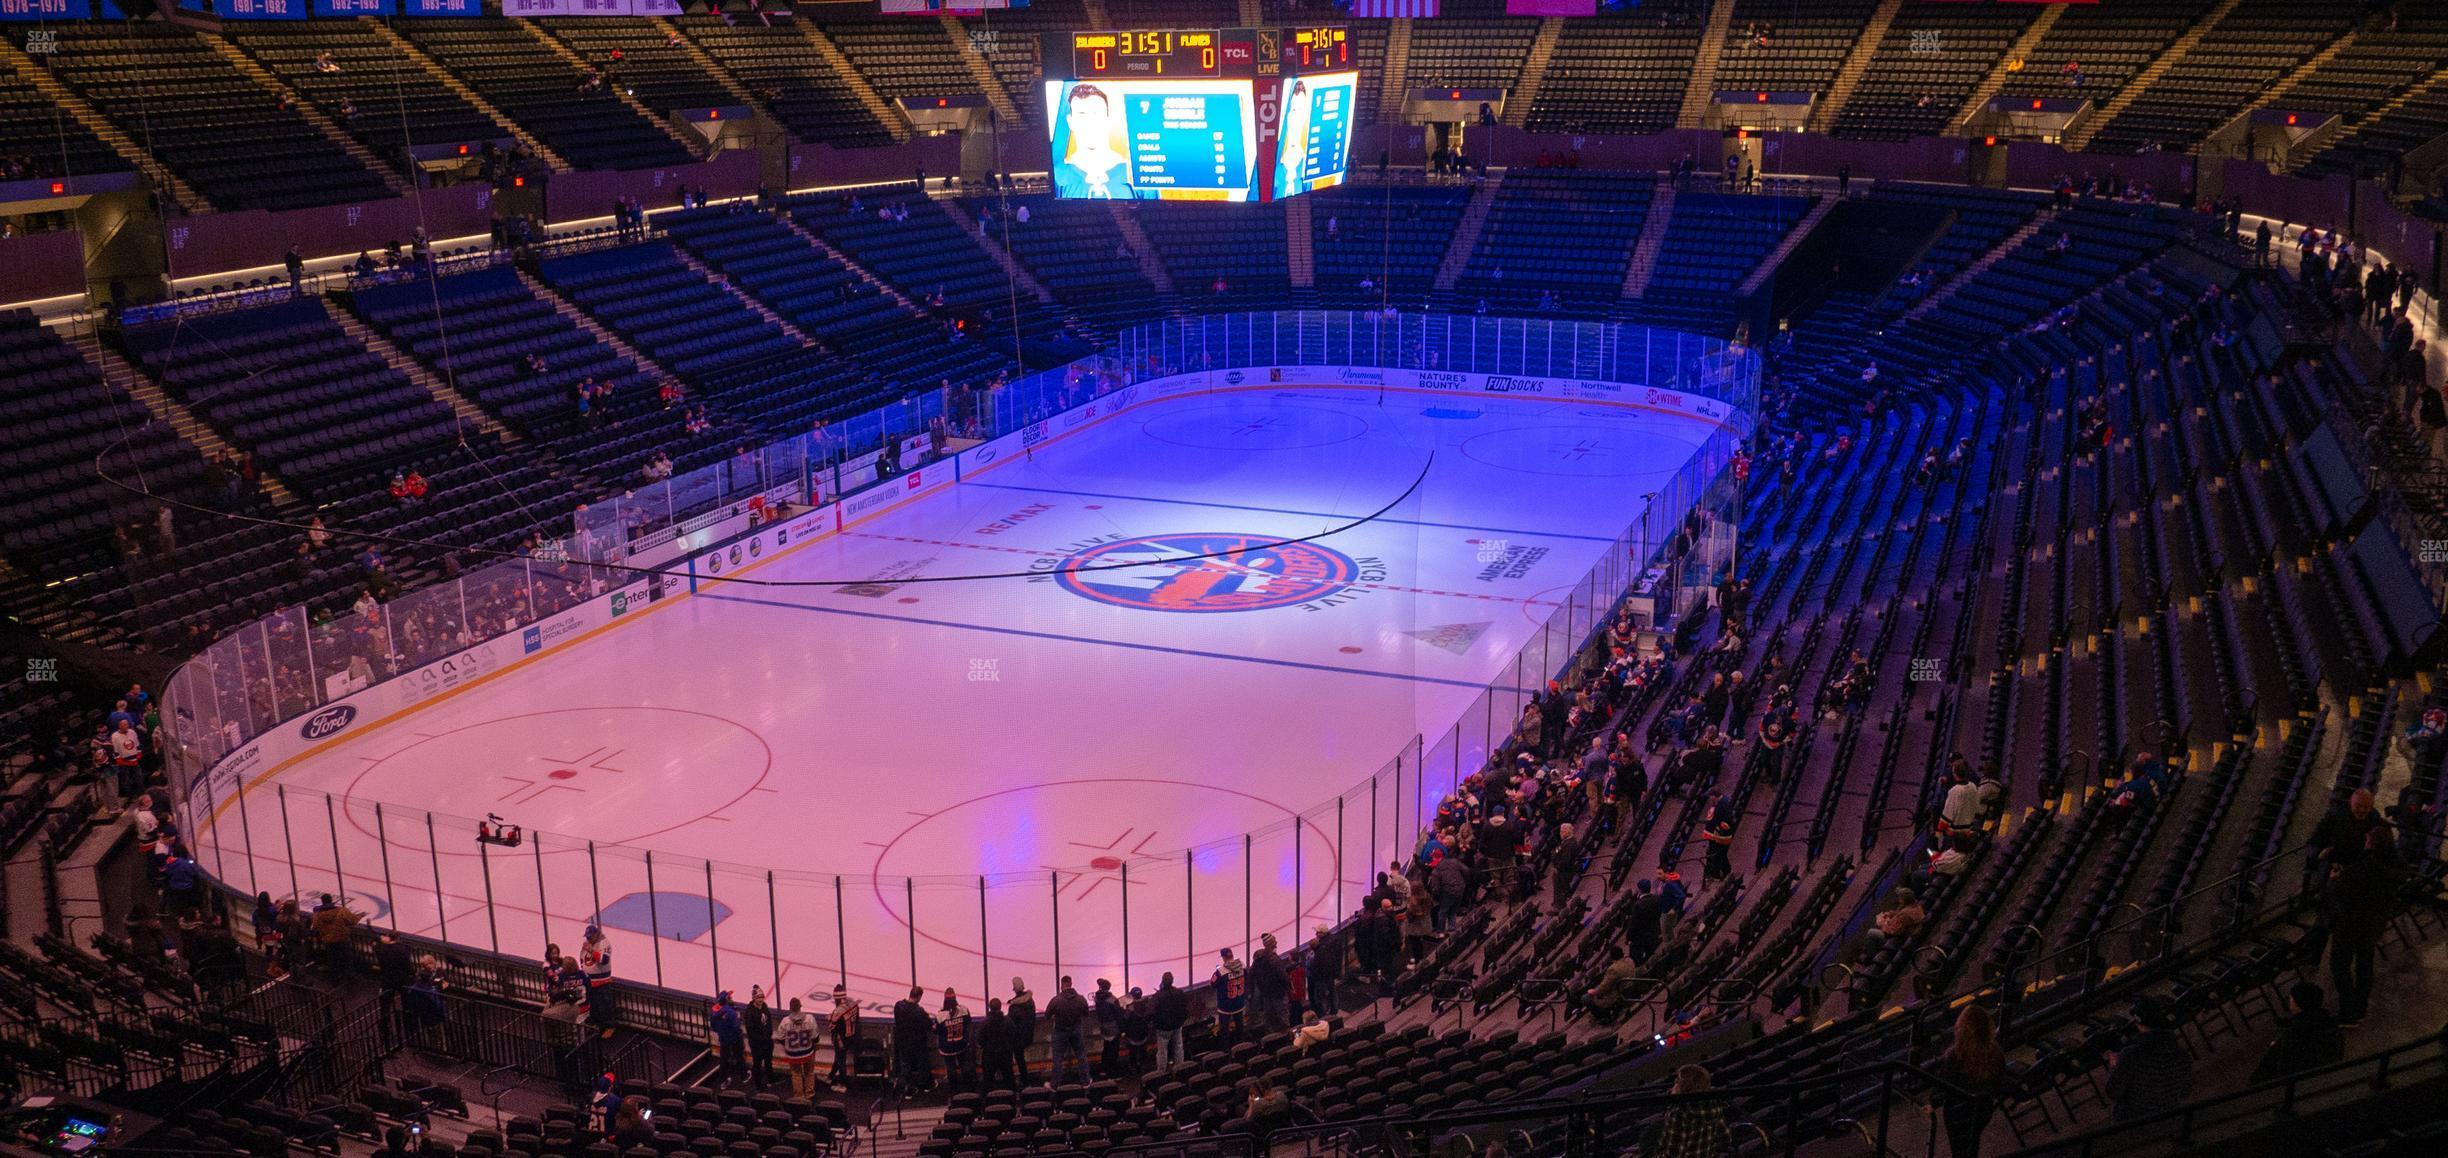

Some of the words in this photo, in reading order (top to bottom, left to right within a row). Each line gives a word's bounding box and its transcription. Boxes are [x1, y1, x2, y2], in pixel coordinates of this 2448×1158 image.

[1121, 32, 1172, 54] 31:51
[1095, 49, 1106, 70] 0
[1202, 48, 1214, 69] 0
[1224, 48, 1249, 59] TCL
[1127, 62, 1149, 71] PERIOD
[1257, 64, 1279, 74] LIVE
[1259, 84, 1277, 143] TCL
[1419, 371, 1467, 383] NATURE'S
[1419, 380, 1460, 390] BOUNTY
[1487, 377, 1511, 391] FUN
[1510, 380, 1544, 392] SOCKS
[1580, 381, 1621, 393] Northwell
[975, 503, 1057, 535] RE/MAX
[1354, 556, 1388, 583] NYCB
[1503, 547, 1551, 580] EXPRESS
[1296, 587, 1372, 613] LIVE
[310, 708, 349, 738] Ford
[787, 1030, 812, 1048] 28
[588, 1114, 606, 1133] 21
